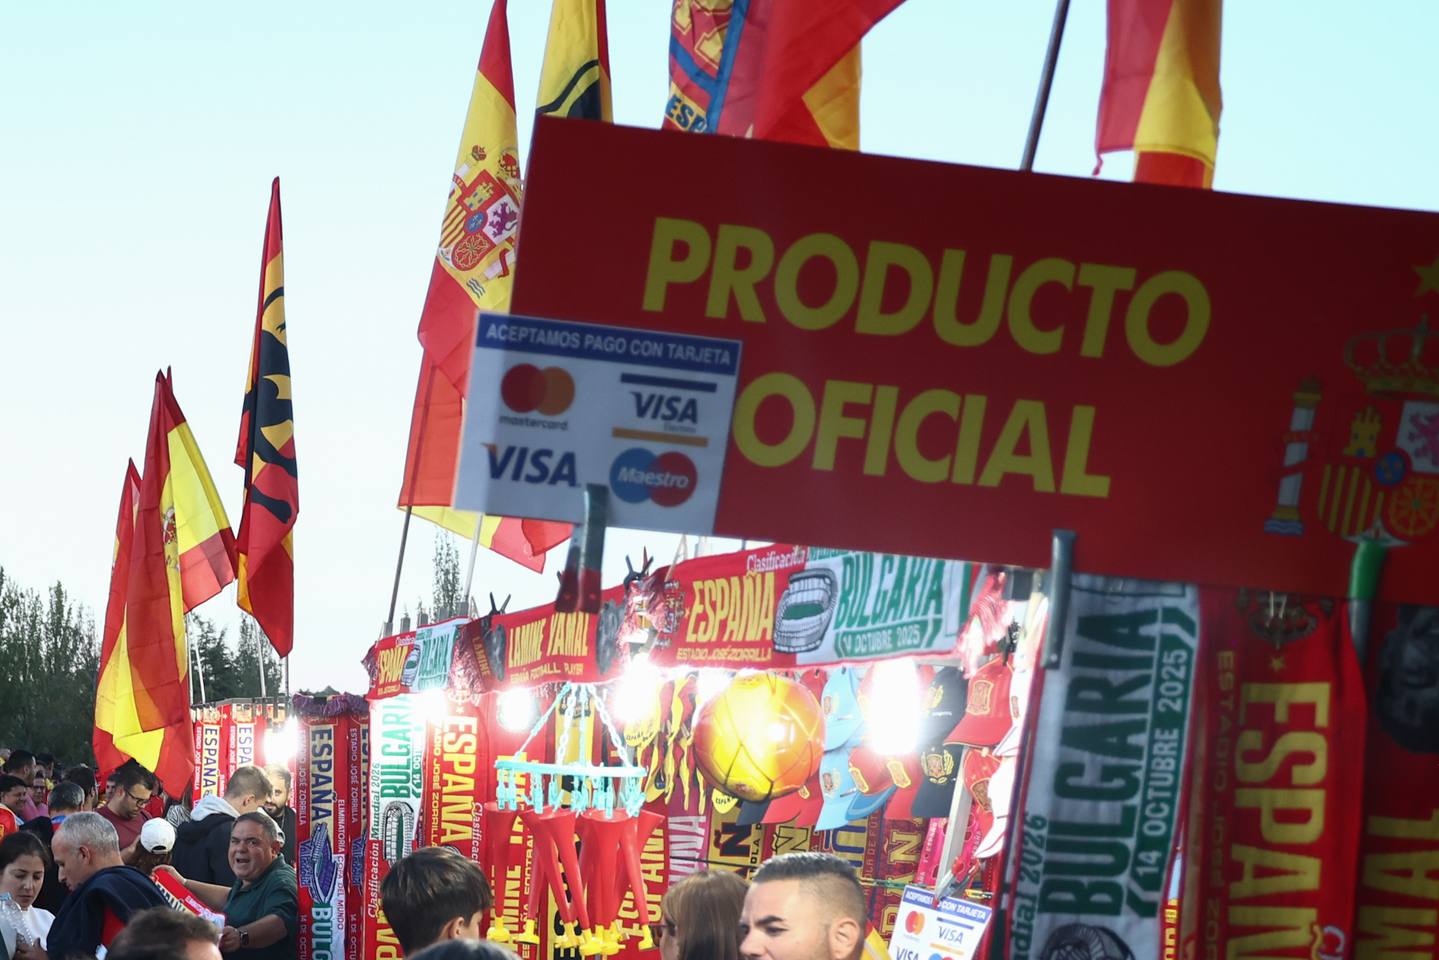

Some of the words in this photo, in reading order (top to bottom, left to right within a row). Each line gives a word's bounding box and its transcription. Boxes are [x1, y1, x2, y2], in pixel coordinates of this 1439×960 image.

[642, 216, 1212, 367] PRODUCTO
[486, 323, 580, 350] ACEPTAMOS
[584, 337, 627, 355] PAGO
[630, 340, 663, 357] CON
[667, 343, 731, 366] TARJETA
[498, 415, 569, 431] mastercard
[629, 391, 698, 425] VISA
[732, 372, 1111, 498] OFICIAL
[480, 441, 578, 488] VISA
[618, 466, 689, 489] Maestro
[685, 570, 775, 643] ESPAÑA
[833, 552, 947, 631] BULGARIA
[508, 618, 547, 669] LAMINE
[546, 611, 590, 657] YAMAL
[854, 629, 894, 650] OCTUBRE
[895, 623, 921, 648] 2025
[1158, 648, 1188, 713] 2025
[203, 728, 221, 788] ESPAÑA
[239, 727, 252, 765] ESPA
[350, 728, 358, 761] ESTADIO
[1036, 606, 1160, 917] BULGARIA
[298, 766, 306, 786] JOSÉ
[311, 728, 337, 822] ESPAÑA
[350, 763, 358, 785] JOSÉ
[371, 762, 380, 788] 2026
[432, 758, 441, 790] JOSÉ
[440, 715, 478, 844] ESPAÑA
[1141, 727, 1179, 838] OCTUBRE
[298, 788, 306, 826] ZORRILLA
[350, 786, 359, 824] ZORRILLA
[370, 789, 381, 841] Mundial
[431, 792, 440, 847] ZORRILLA
[471, 802, 483, 864] Clasificaci
[1024, 812, 1049, 884] 2026
[368, 842, 380, 918] Clasificación
[1136, 850, 1160, 878] 14
[337, 900, 345, 930] MUNDO
[941, 901, 957, 913] CON
[956, 903, 987, 920] TARJETA
[938, 925, 964, 944] VISA
